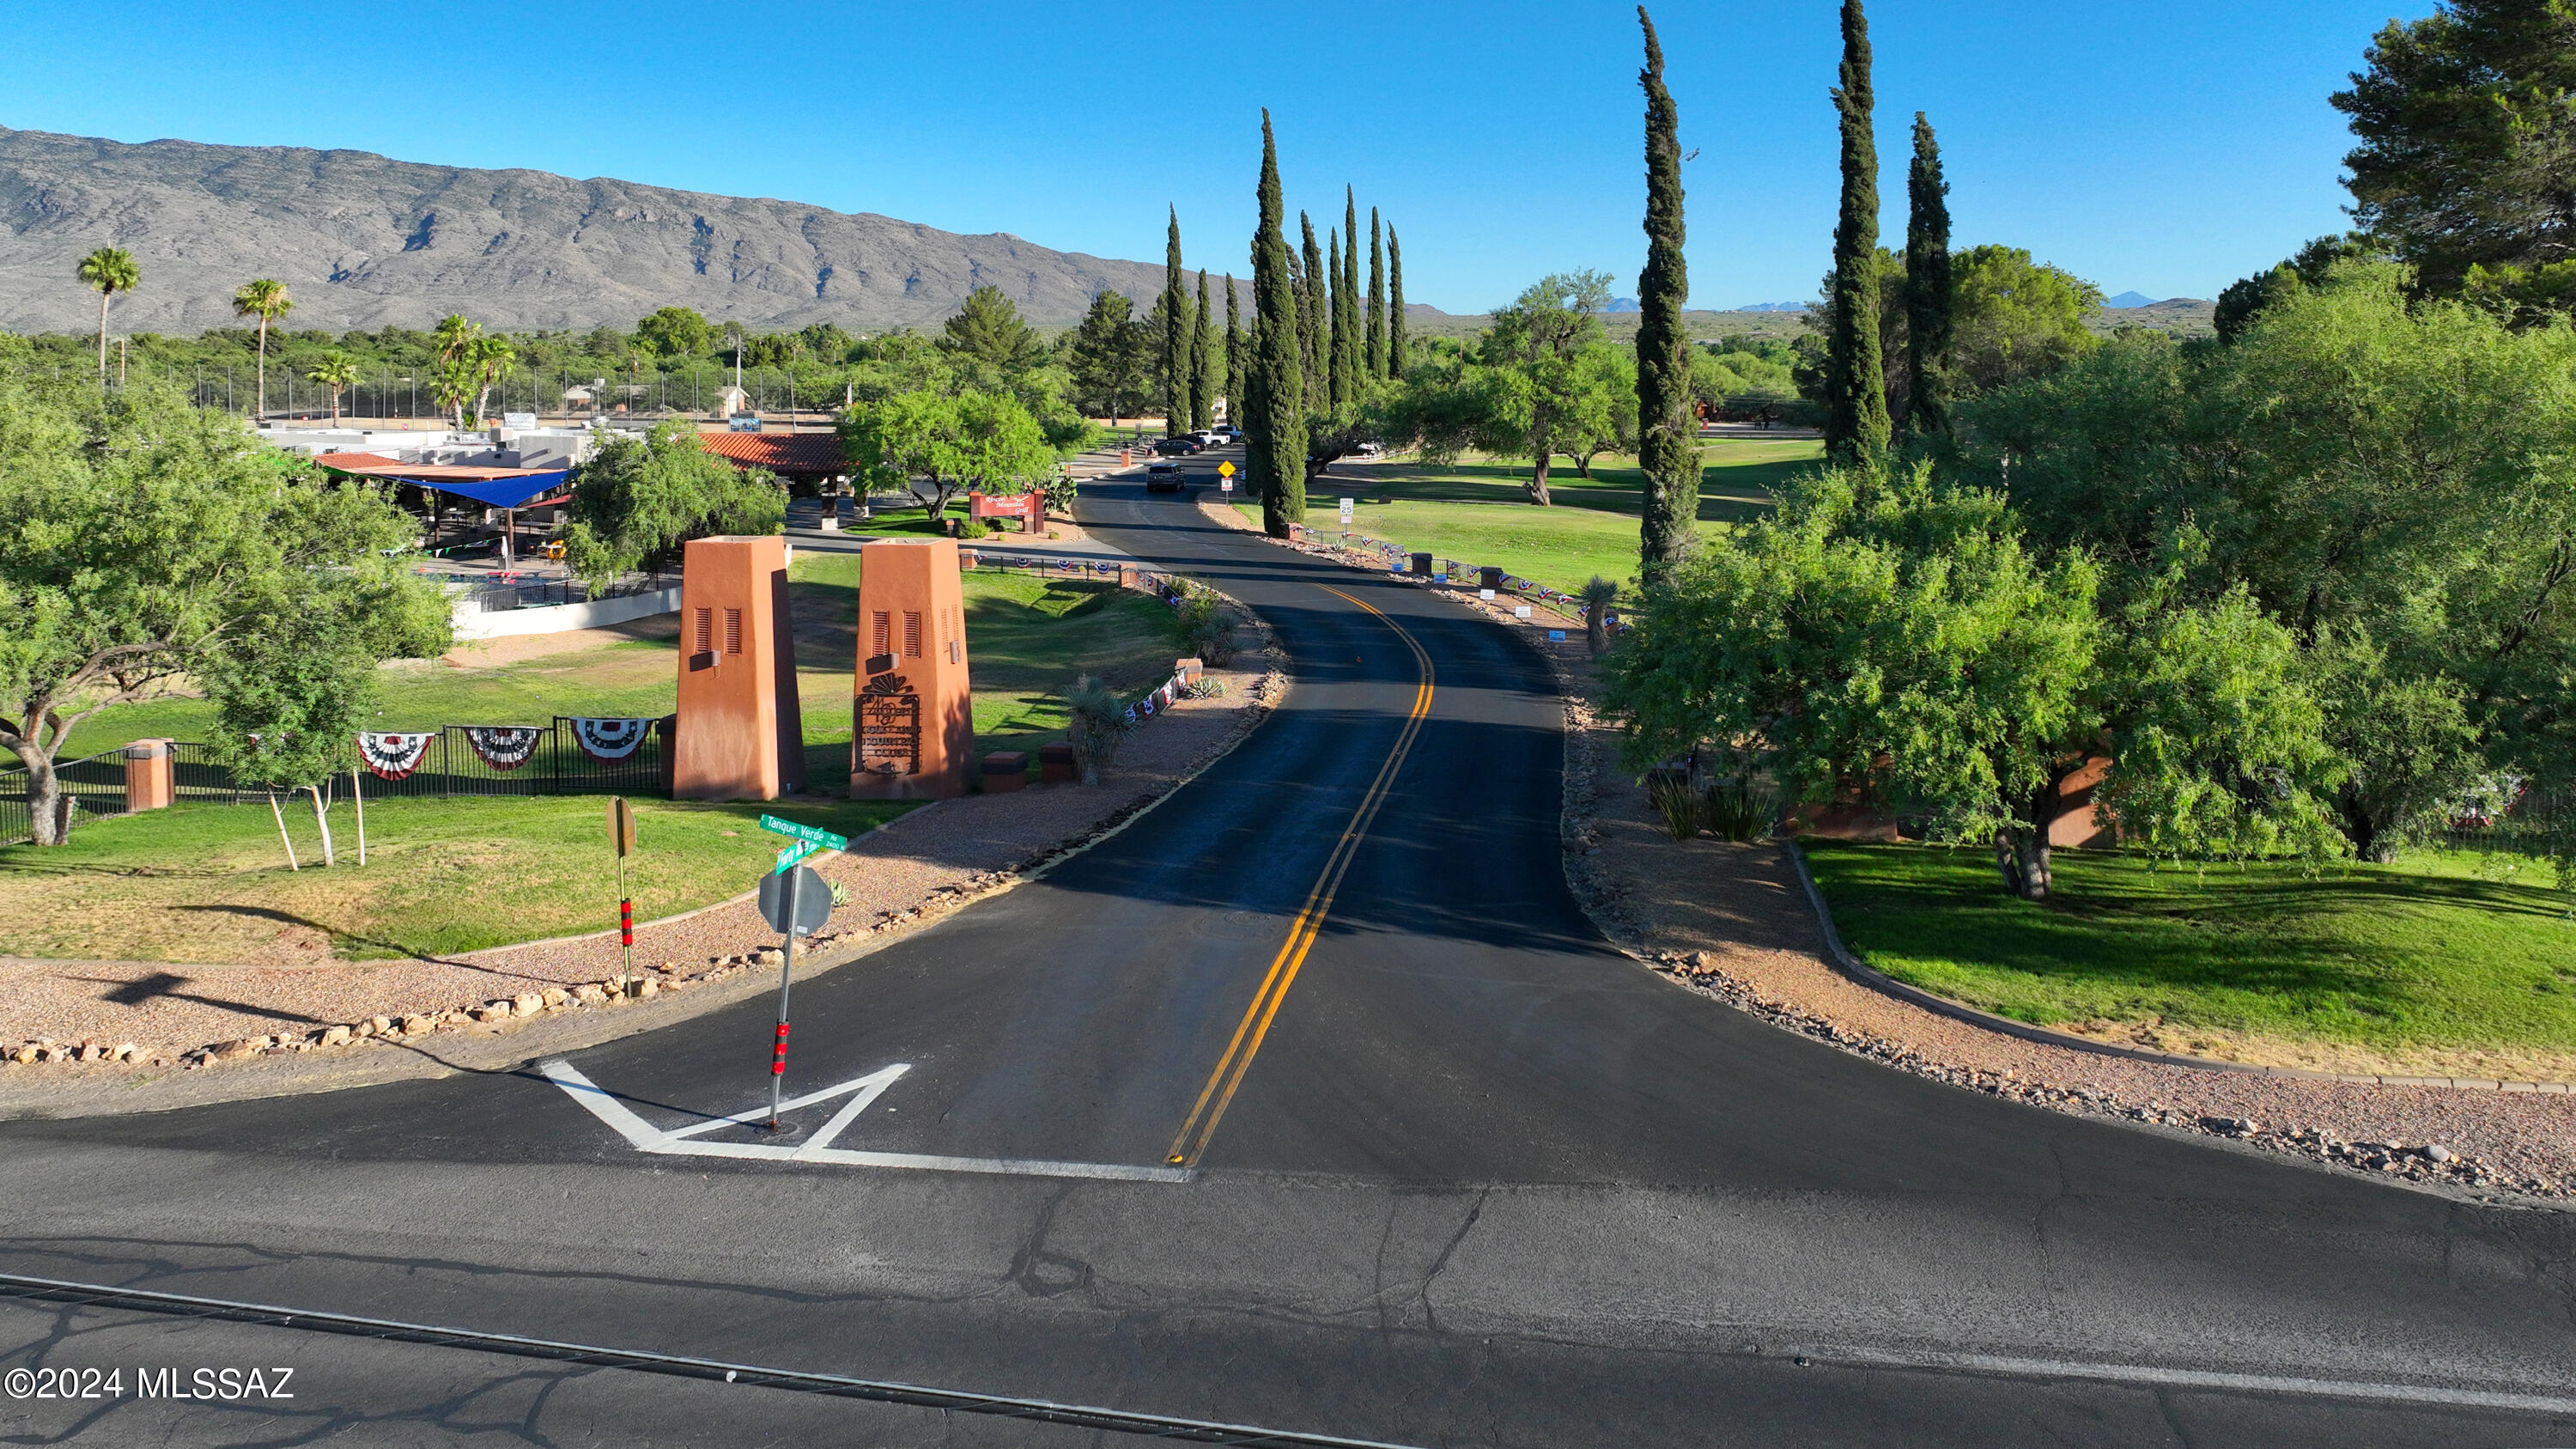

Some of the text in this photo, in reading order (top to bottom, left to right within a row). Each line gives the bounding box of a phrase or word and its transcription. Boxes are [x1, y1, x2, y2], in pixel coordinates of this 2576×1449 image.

[768, 815, 797, 834] Tanque
[800, 825, 824, 842] Verde
[825, 841, 839, 849] 2400
